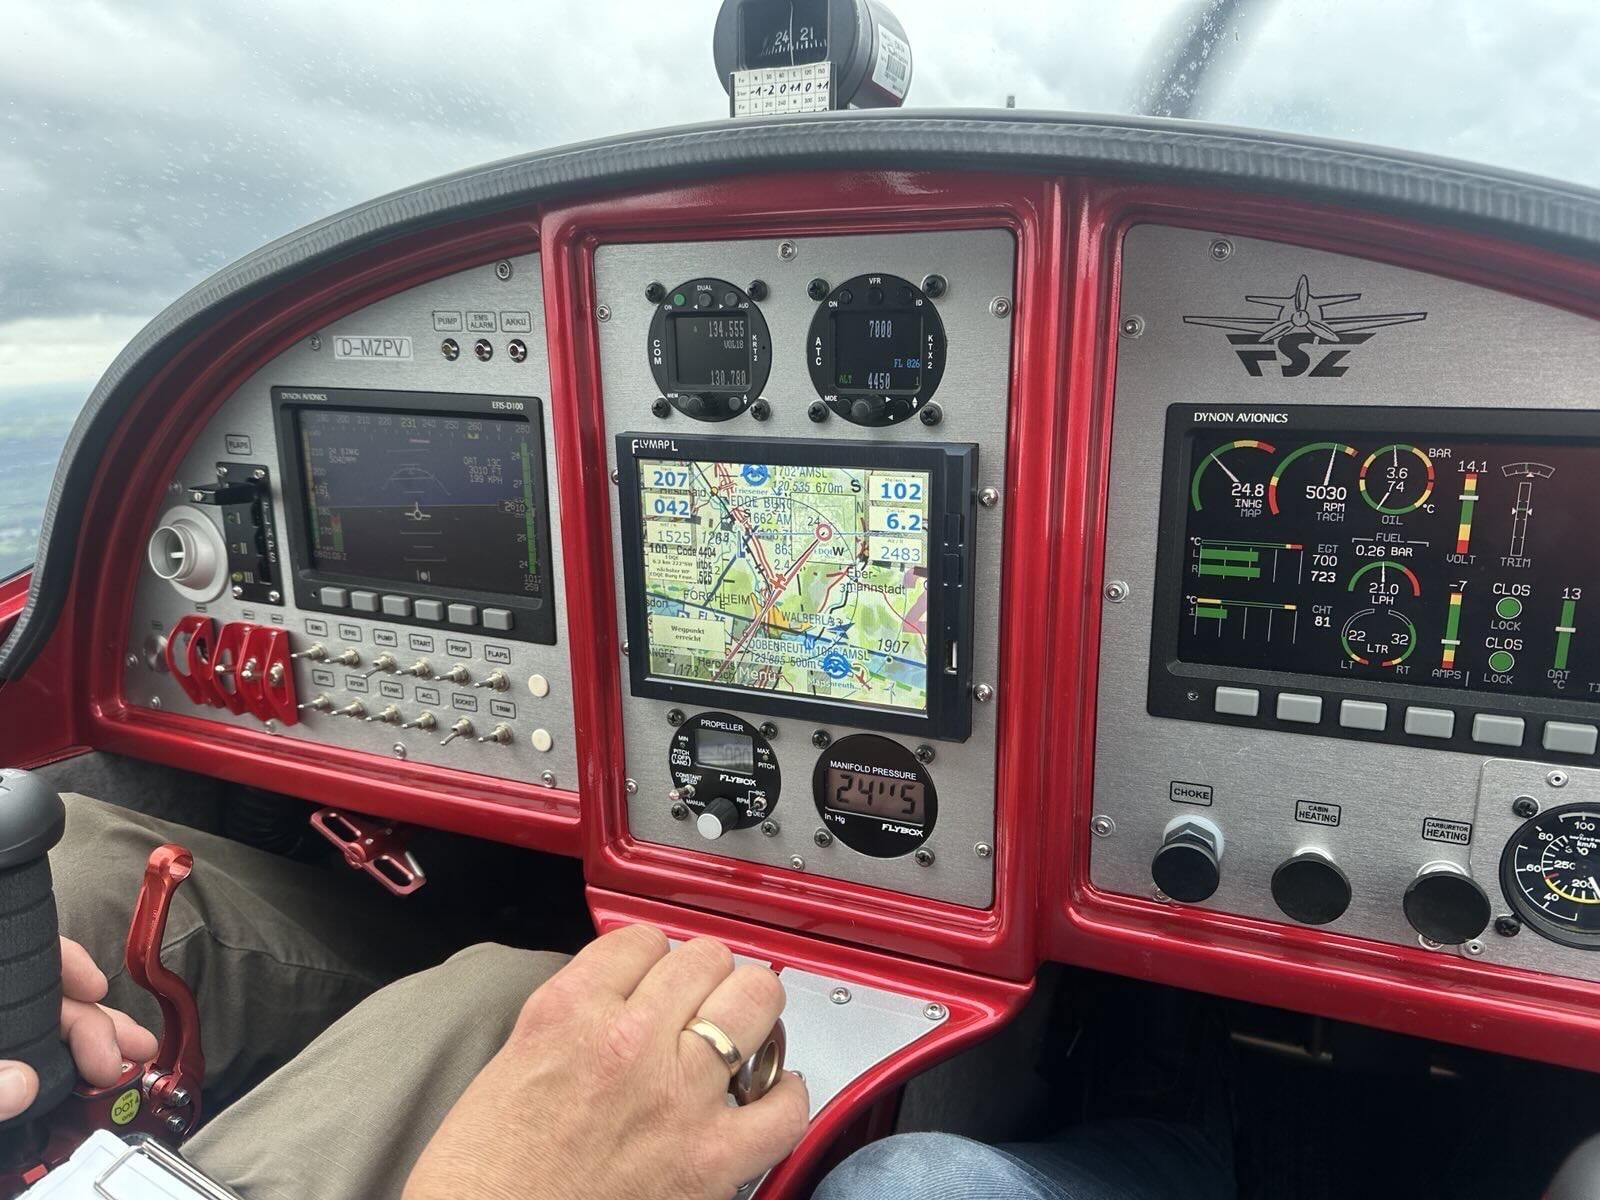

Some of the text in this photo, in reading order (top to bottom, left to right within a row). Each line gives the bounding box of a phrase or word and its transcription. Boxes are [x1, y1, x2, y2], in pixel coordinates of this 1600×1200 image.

[774, 27, 814, 46] 24 21
[780, 84, 787, 95] 0
[805, 82, 812, 92] 0
[869, 277, 881, 285] VFR
[697, 284, 712, 292] DUAL
[437, 317, 458, 326] PUMP
[474, 314, 488, 322] EMS
[505, 318, 527, 327] AKKU
[470, 320, 495, 329] ALARM
[708, 320, 745, 338] 134.555
[869, 320, 892, 338] 7000
[342, 339, 404, 357] D-MZPV
[653, 339, 662, 365] COM
[906, 358, 921, 368] 026
[867, 372, 891, 390] 4450
[401, 417, 417, 428] 231
[1194, 412, 1289, 424] DYNON AVIONICS
[632, 439, 670, 454] FLYMAP
[1429, 448, 1451, 458] BAR
[1457, 461, 1488, 473] 14.1
[653, 470, 688, 487] 207
[1386, 467, 1408, 480] 3.6
[816, 482, 843, 494] 670m
[850, 479, 862, 493] S
[881, 482, 921, 500] 102
[1231, 483, 1264, 497] 24.8
[1388, 481, 1404, 493] 74
[1306, 486, 1347, 500] 5030
[654, 499, 690, 516] 042
[1235, 499, 1262, 508] INHG
[1323, 503, 1345, 512] RPM
[754, 513, 772, 525] 662
[1241, 509, 1261, 518] MAP
[1316, 512, 1344, 522] TACH
[887, 513, 921, 531] 6.2
[1381, 515, 1403, 525] OIL
[658, 530, 691, 545] 1525
[1375, 533, 1405, 543] FUEL
[677, 545, 697, 556] Code
[881, 546, 921, 562] 2483
[1318, 544, 1339, 554] EGT
[1355, 544, 1413, 557] 0.26 BAR
[1312, 555, 1338, 567] 700
[1446, 554, 1476, 565] VOLT
[1500, 558, 1531, 568] TRIM
[1310, 571, 1336, 583] 723
[1369, 582, 1399, 595] 21.0
[1492, 582, 1531, 596] CLOS
[1561, 587, 1582, 600] 13
[1372, 596, 1394, 605] LPH
[1312, 605, 1333, 615] CHT
[1314, 616, 1331, 627] 81
[1491, 620, 1521, 631] LOCK
[1348, 630, 1366, 642] 22
[1391, 633, 1409, 645] 32
[878, 638, 910, 653] 1907
[1367, 644, 1389, 654] LTR
[1485, 637, 1523, 651] CLOS
[488, 650, 508, 659] FLAPS
[1340, 660, 1355, 670] LT
[1396, 665, 1411, 675] RT
[1431, 668, 1462, 680] AMPS
[1483, 673, 1514, 684] LOCK
[1547, 669, 1570, 680] OAT
[701, 719, 744, 732] PROPELLER
[758, 762, 775, 770] PITCH
[830, 760, 917, 781] MANIFOLD PRESSURE
[675, 771, 702, 781] CONSTANT
[719, 774, 757, 787] FLYBOX
[1173, 787, 1209, 800] CHOKE
[686, 799, 706, 807] MANUAL
[1308, 805, 1329, 813] CABIN
[835, 815, 846, 825] Hg
[1299, 810, 1337, 823] HEATING
[881, 823, 924, 838] FLYBOX
[1427, 822, 1469, 833] CARBURETOR
[1574, 821, 1595, 831] 100
[1426, 829, 1467, 842] HEATING
[1538, 832, 1554, 841] 80
[1577, 840, 1597, 848] km/h
[1526, 864, 1541, 873] 60
[1543, 893, 1559, 902] 40
[115, 1099, 133, 1116] DOT
